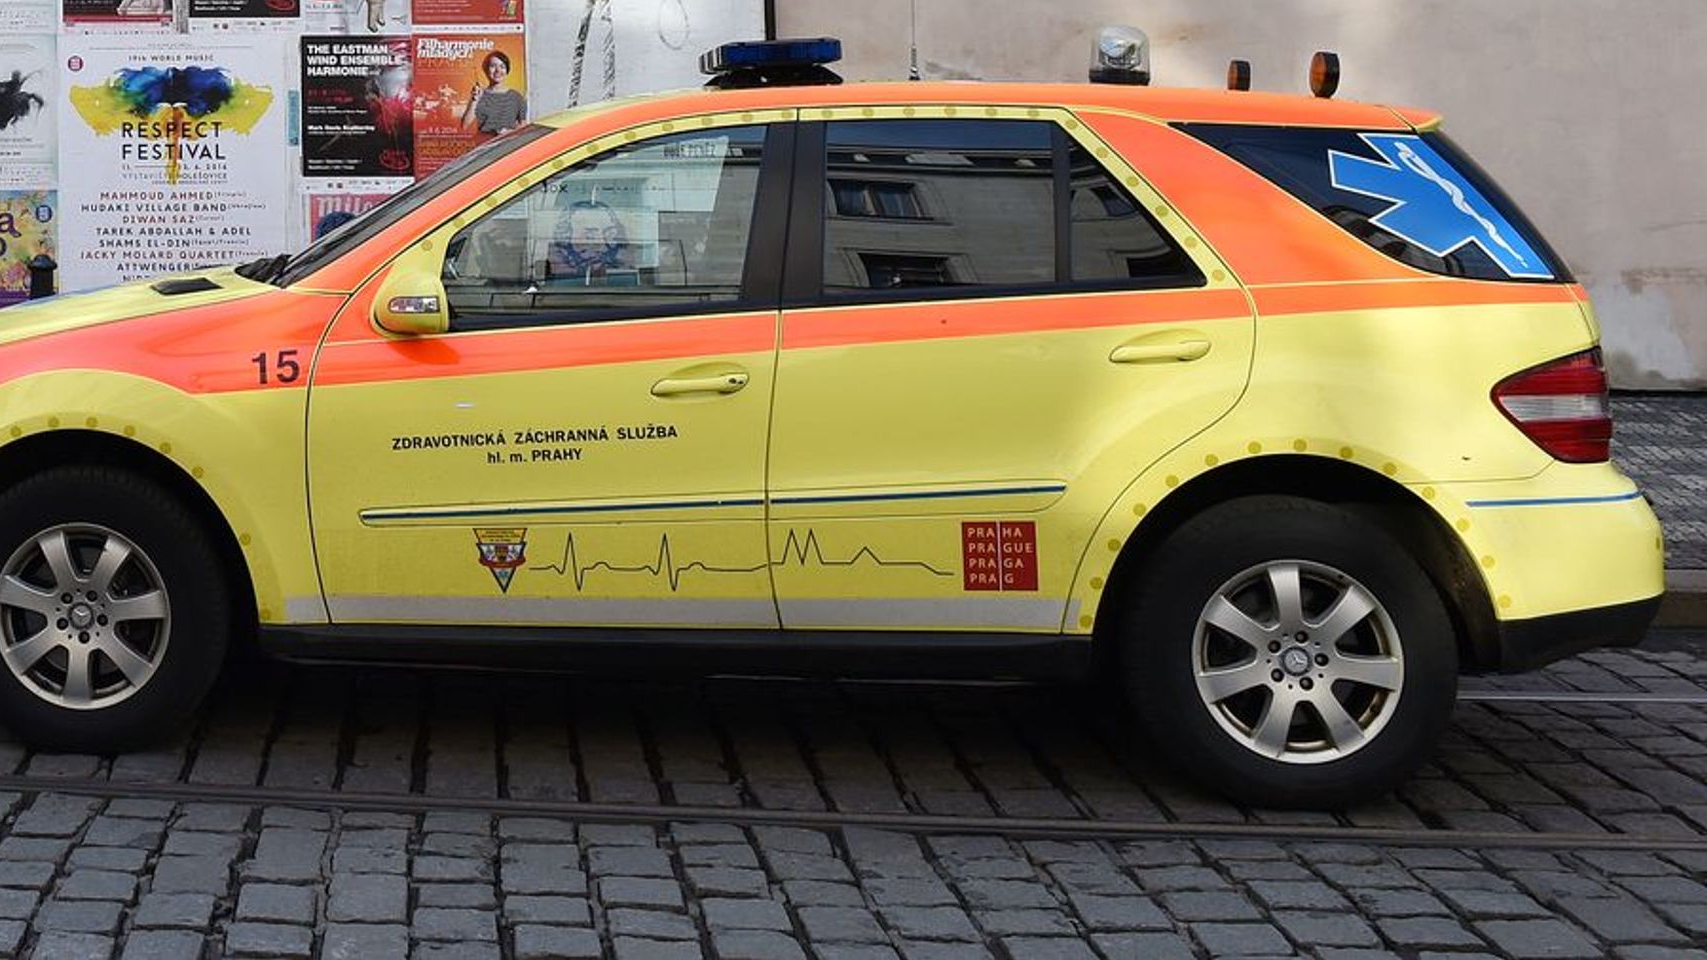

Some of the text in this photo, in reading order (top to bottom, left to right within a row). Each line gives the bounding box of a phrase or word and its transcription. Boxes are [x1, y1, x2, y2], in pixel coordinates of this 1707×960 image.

[307, 44, 388, 54] THE EASTMAN
[307, 55, 337, 65] WIND
[307, 66, 368, 76] HARMONIE
[122, 122, 224, 139] RESPECT
[122, 144, 227, 160] FESTIVAL
[100, 192, 165, 200] MAHMOUD
[170, 192, 213, 200] AHMED
[81, 203, 130, 212] HUDAKI
[135, 203, 188, 212] VILLAGE
[194, 203, 227, 212] BAND
[123, 215, 166, 223] DIWAN
[172, 215, 195, 223] SAZ
[96, 227, 134, 235] TAREK
[140, 227, 202, 235] ABDALLAH
[221, 227, 251, 235] ADEL
[99, 239, 141, 247] SHAMS
[147, 239, 190, 247] EL-DIN
[123, 250, 173, 259] MOLARD
[179, 250, 234, 259] QUARTET
[252, 350, 300, 385] 15
[392, 424, 678, 450] ZDRAVOTNICKÁ ZÁCHRANNÁ SLUŽBA
[487, 448, 582, 465] hl. m. PRAHY
